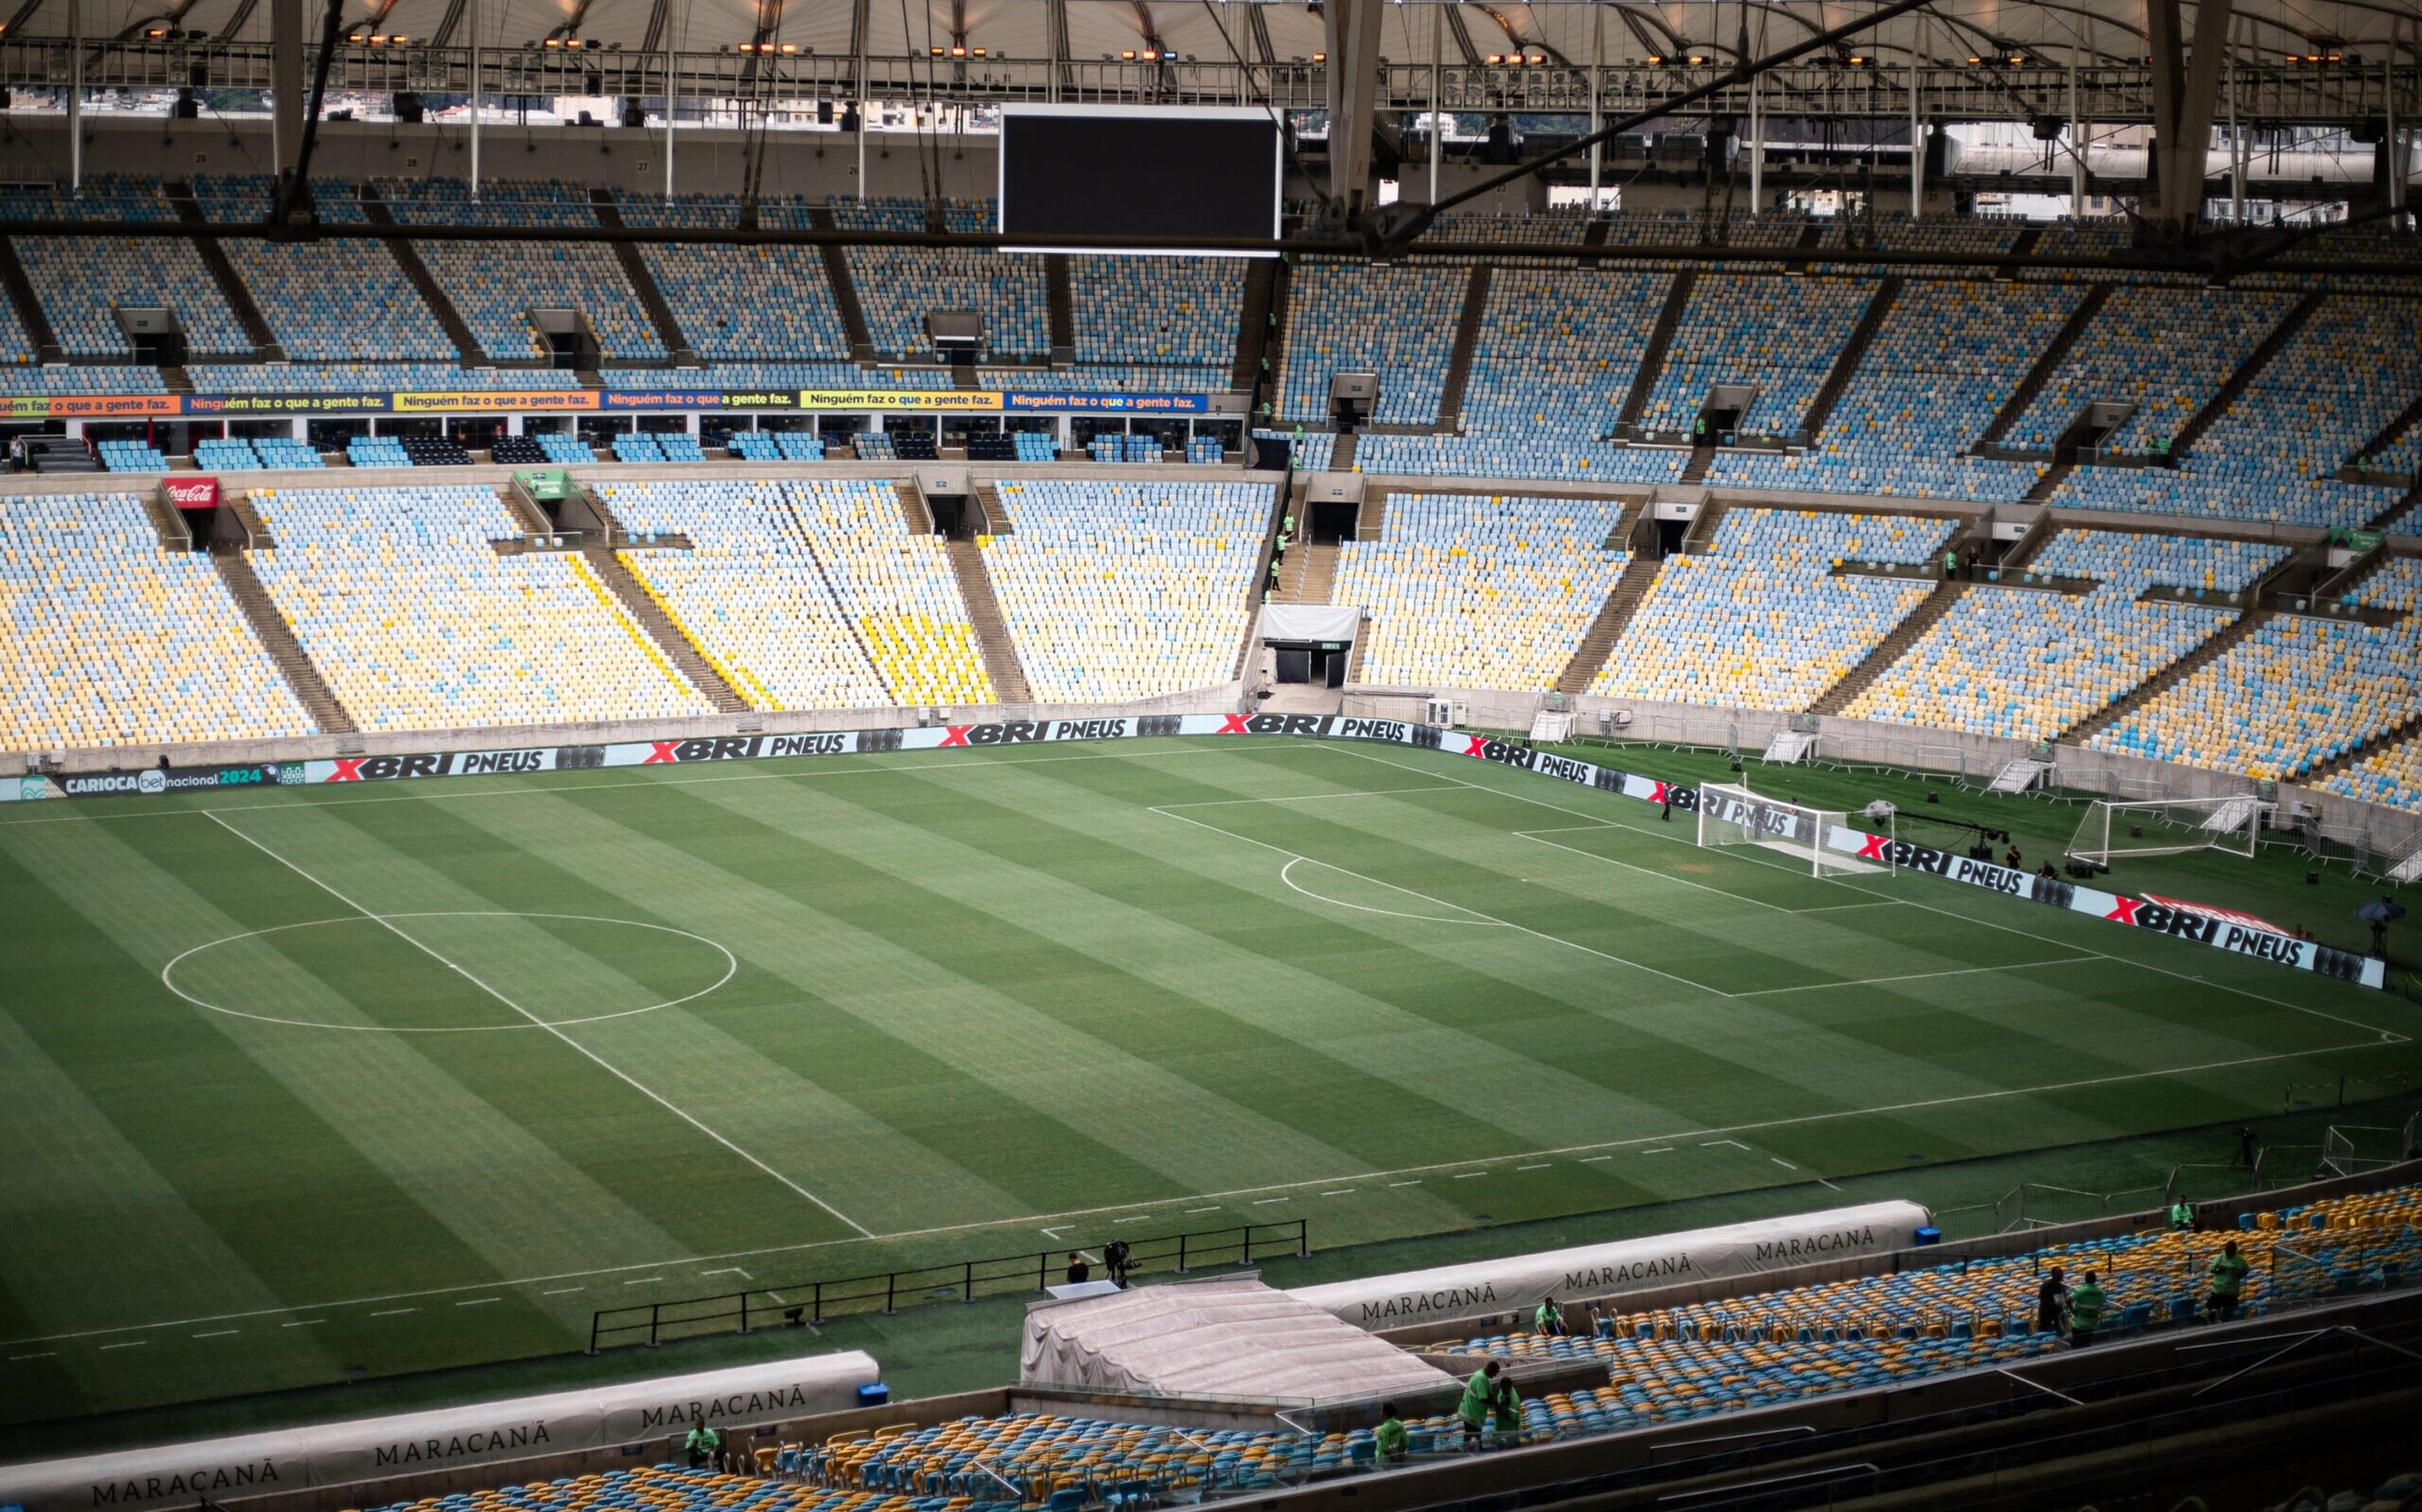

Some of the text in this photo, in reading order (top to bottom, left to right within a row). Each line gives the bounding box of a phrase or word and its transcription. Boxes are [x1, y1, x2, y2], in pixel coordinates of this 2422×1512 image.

[196, 154, 206, 163] 29
[407, 158, 418, 167] 28
[638, 162, 648, 171] 27
[32, 402, 50, 411] faz
[67, 402, 91, 412] que
[107, 400, 143, 411] gente
[147, 399, 170, 409] faz.
[190, 397, 384, 410] Ninguém faz o que a gente faz.
[404, 395, 459, 407] Ninguém
[462, 396, 480, 405] faz
[494, 397, 517, 406] que
[531, 395, 565, 406] gente
[568, 395, 589, 404] faz.
[608, 393, 792, 405] Ninguém faz o que a gente faz.
[810, 393, 993, 405] Ninguém faz o que a gente faz.
[1012, 395, 1195, 409] Ninguém faz o que a gente faz.
[938, 719, 1126, 747] XBRI PNEUS
[1215, 713, 1405, 741] XBRI PNEUS
[643, 734, 845, 764] XBRI PNEUS
[1463, 735, 1589, 783] XBRI PNEUS
[324, 751, 544, 782] XBRI PNEUS
[66, 776, 137, 793] CARIOCA
[219, 769, 262, 784] 2024
[1856, 833, 2023, 895] XBRI PNEUS
[2105, 895, 2222, 945] XBRI
[2224, 926, 2304, 966] PNEUS
[1756, 1226, 1874, 1260] MARACANÃ
[1565, 1253, 1691, 1289] MARACANÃ
[1362, 1282, 1496, 1320] MARACANÃ
[641, 1383, 806, 1428] MARACANÃ
[375, 1420, 551, 1467] MARACANÃ
[92, 1458, 279, 1506] MARACANÃ
